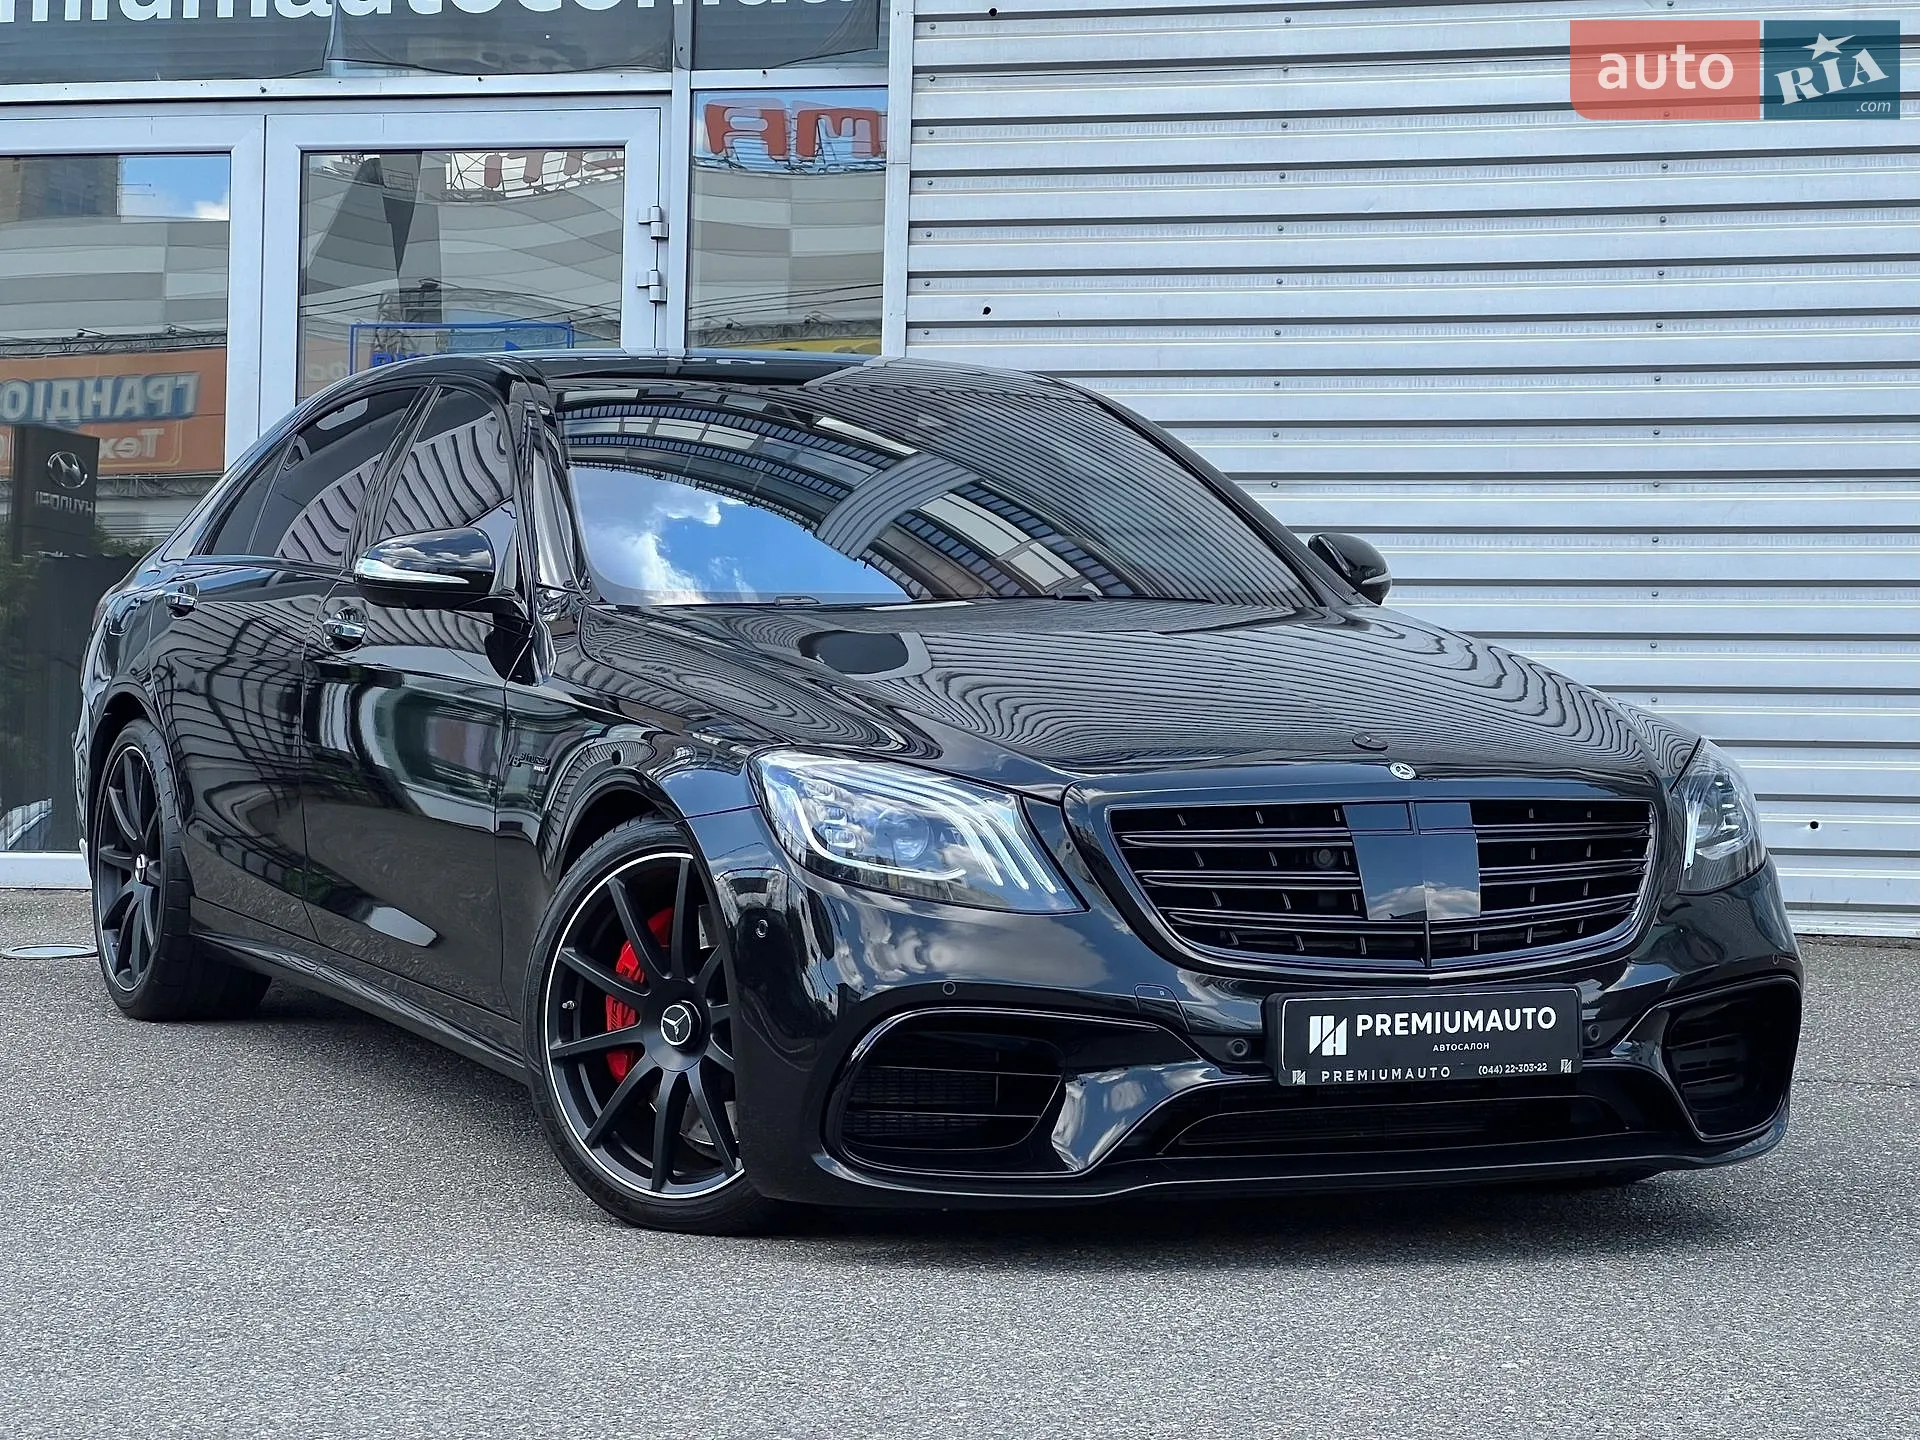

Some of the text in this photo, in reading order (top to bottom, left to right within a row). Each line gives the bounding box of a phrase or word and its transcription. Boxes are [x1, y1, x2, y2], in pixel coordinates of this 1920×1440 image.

[1356, 1006, 1557, 1037] PREMIUMAUTO
[1432, 1042, 1490, 1052] АВТОСАЛОН
[1321, 1062, 1548, 1083] PREMIUMAUTO (044) 22-303-22
